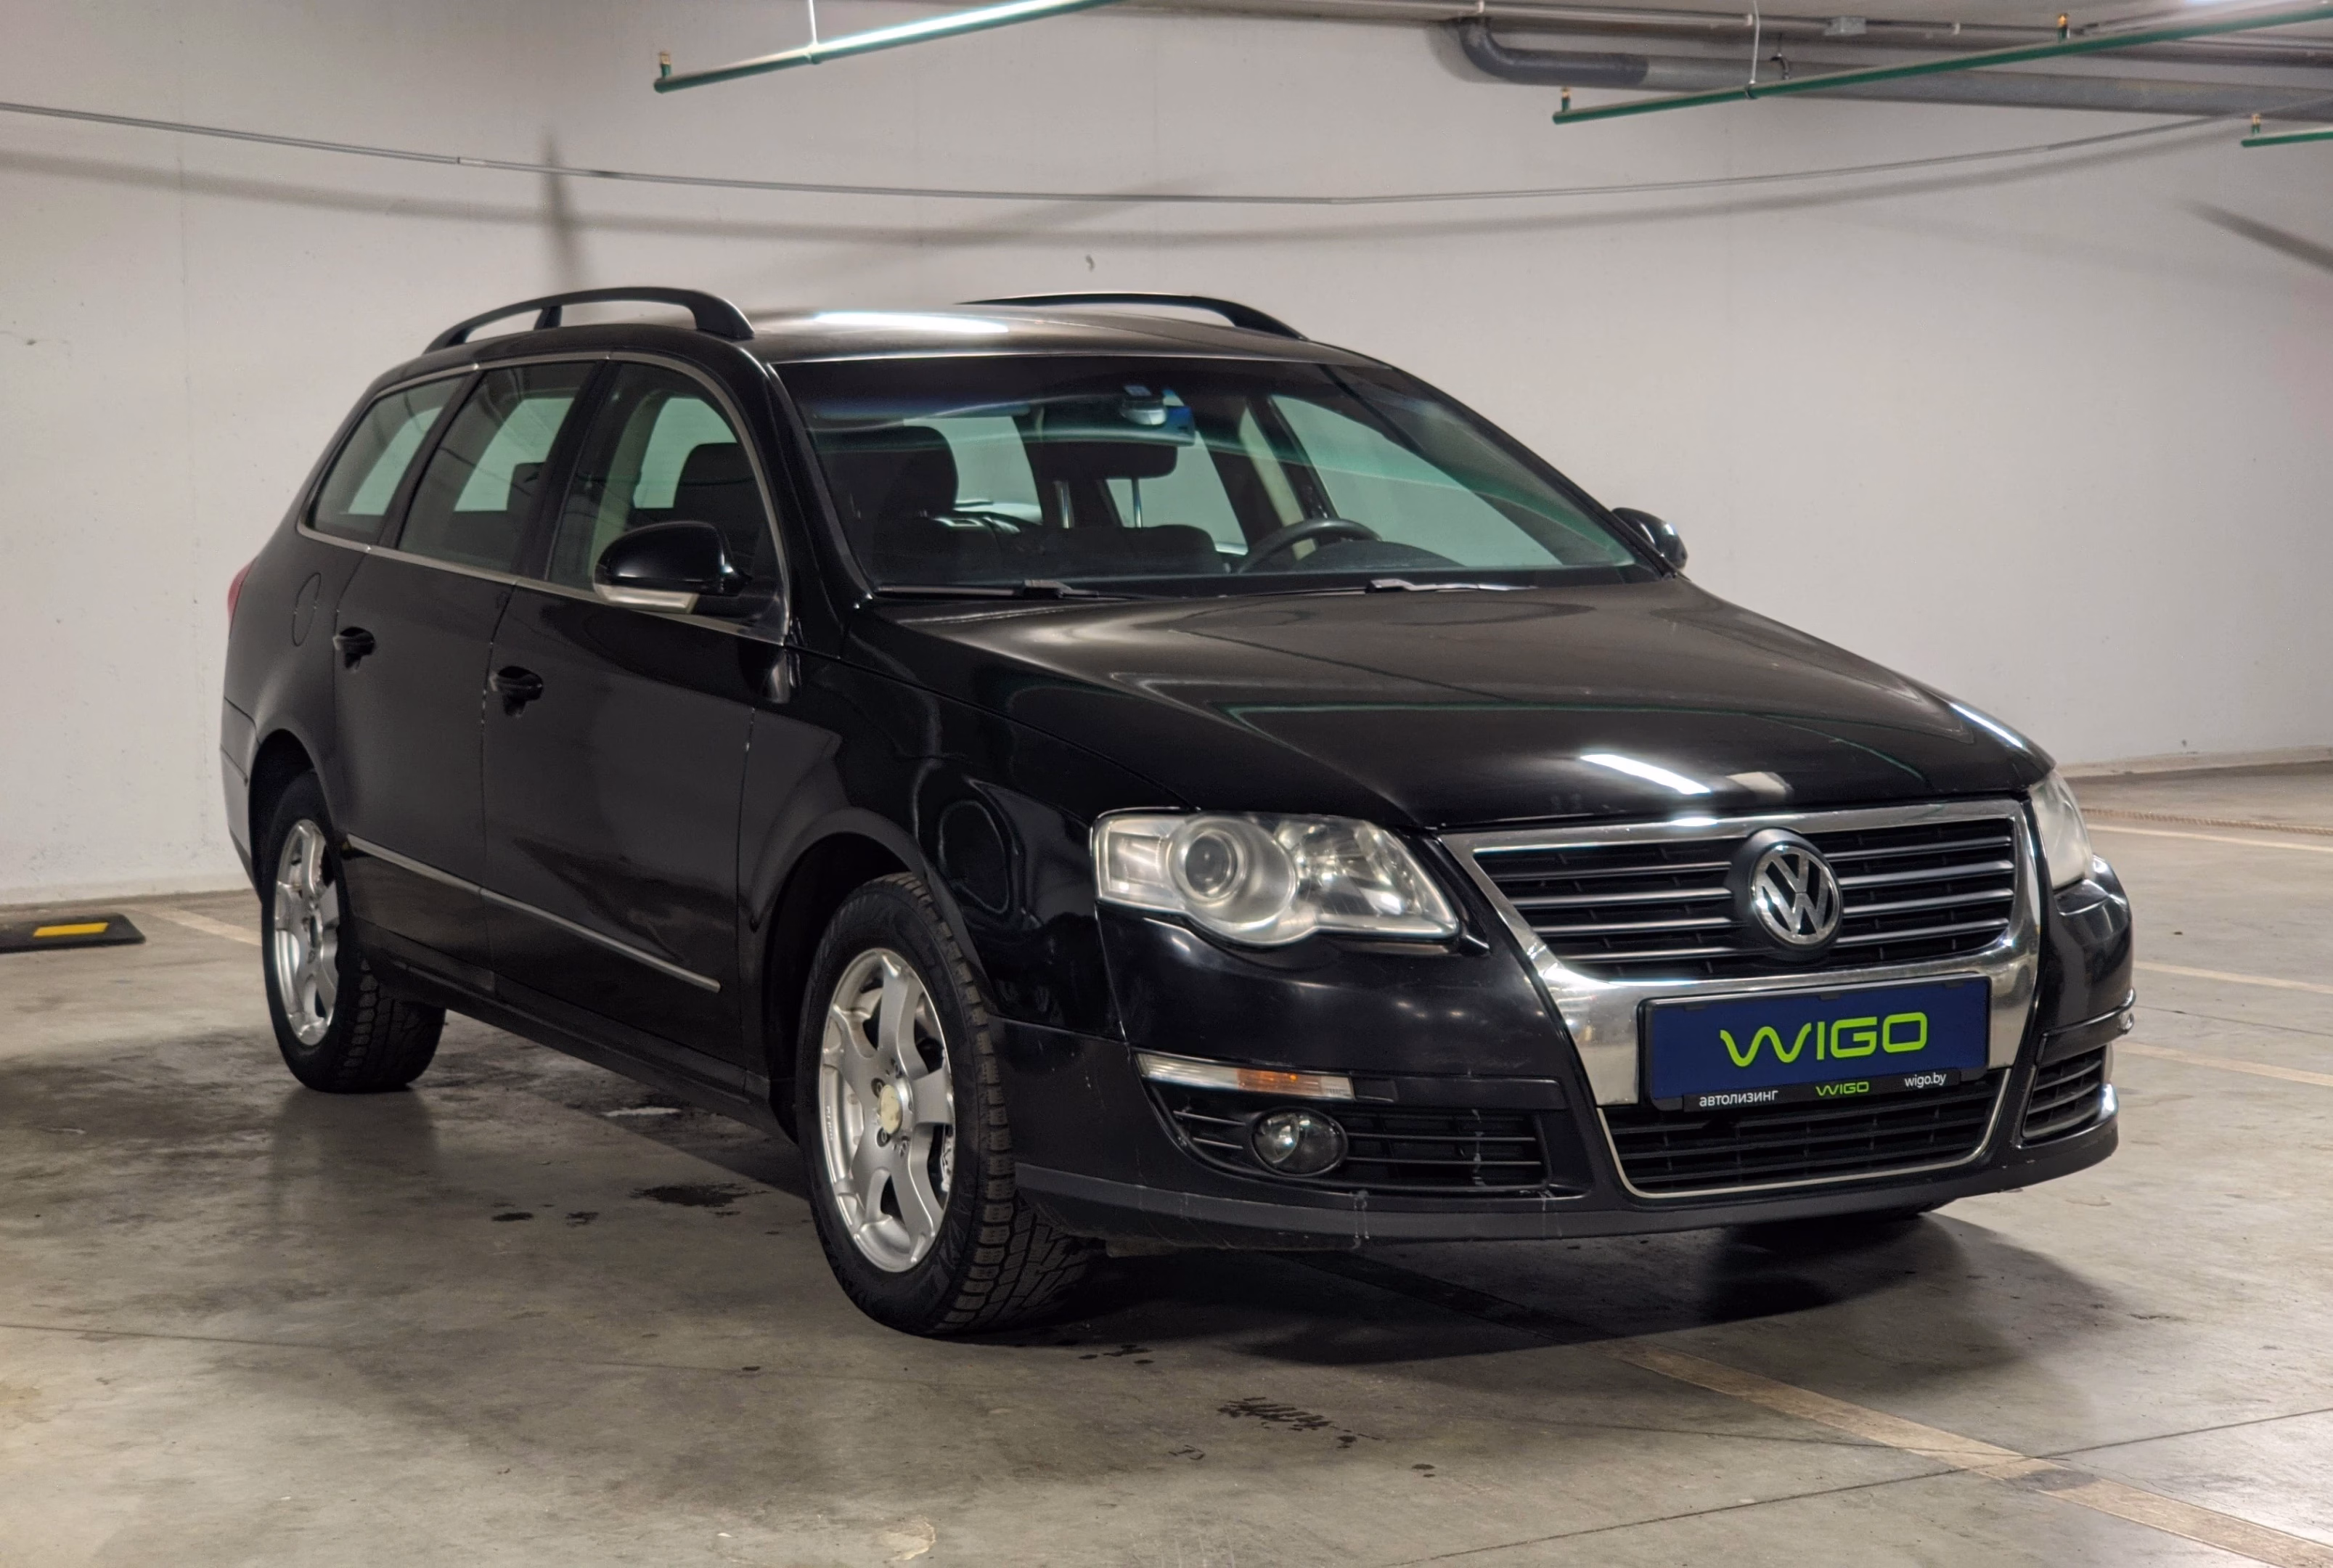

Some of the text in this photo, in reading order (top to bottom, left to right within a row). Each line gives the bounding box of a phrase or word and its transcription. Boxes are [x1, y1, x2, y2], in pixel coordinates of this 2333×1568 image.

[1752, 847, 1838, 943] VW
[1720, 1011, 1927, 1067] WIGO
[1699, 1071, 1947, 1107] автолизинг WIGO wigo.by
